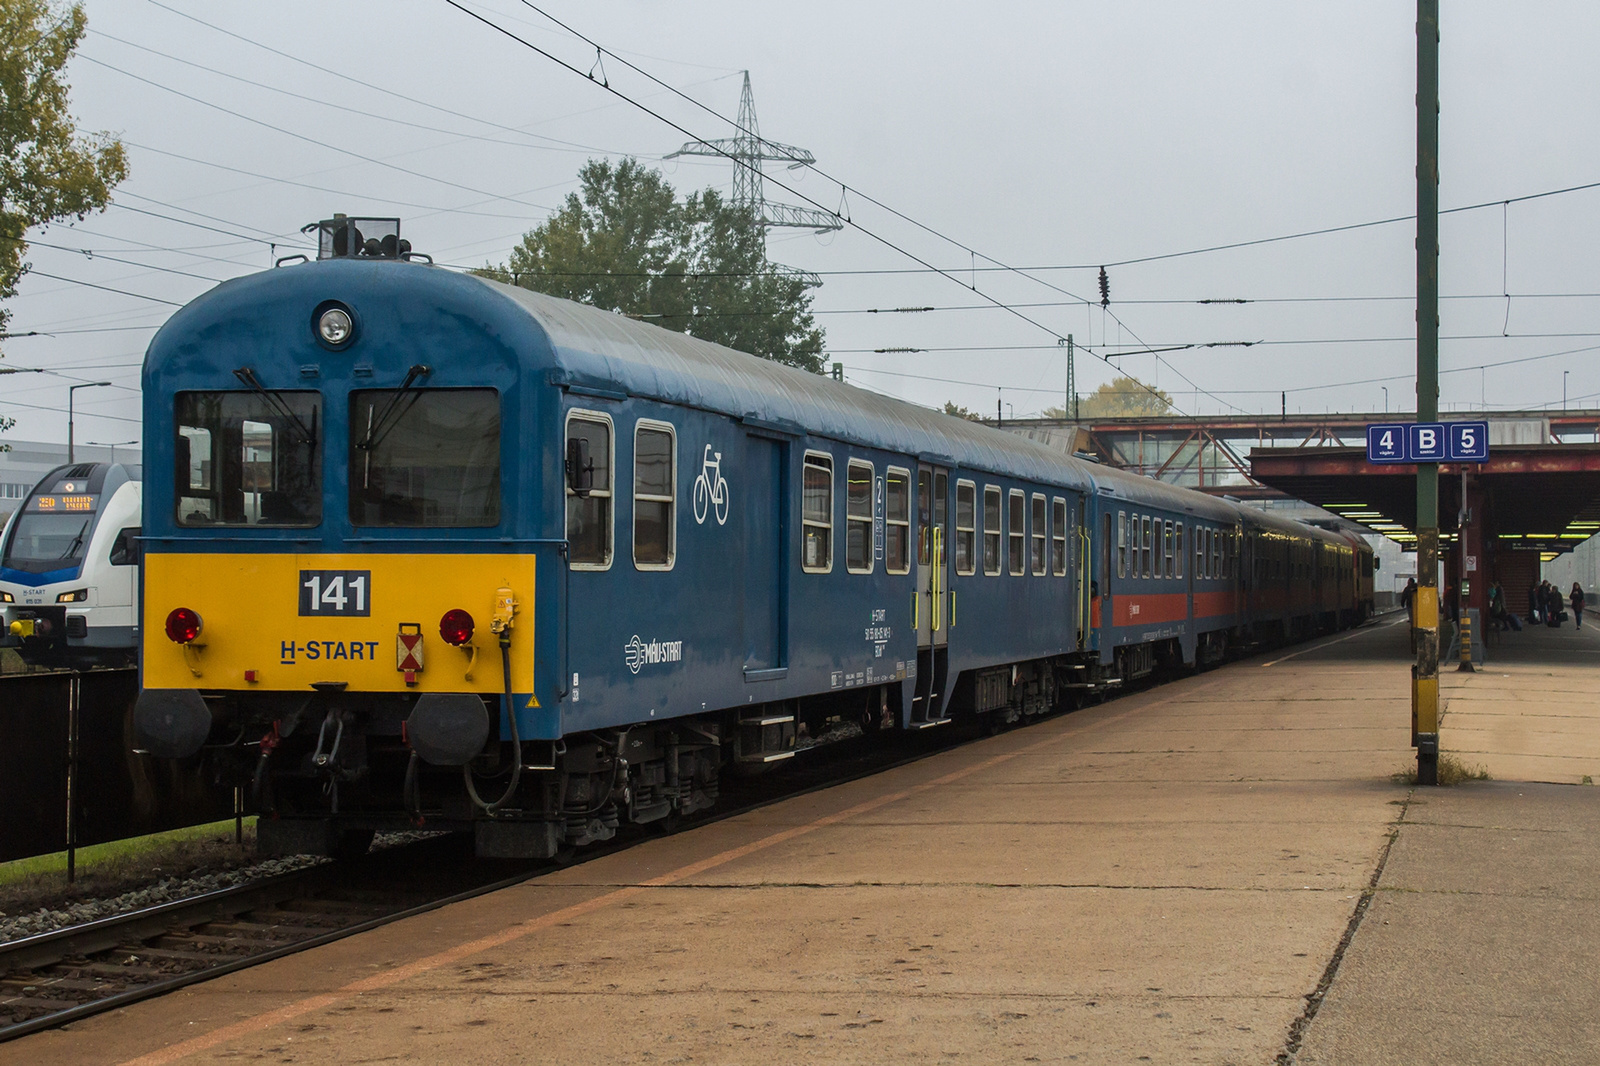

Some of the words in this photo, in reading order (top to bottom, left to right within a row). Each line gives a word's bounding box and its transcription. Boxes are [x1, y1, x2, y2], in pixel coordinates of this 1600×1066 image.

[1379, 430, 1394, 450] 4
[1419, 429, 1437, 449] B
[1460, 428, 1475, 449] 5
[877, 480, 882, 504] 2
[304, 576, 365, 611] 141
[280, 640, 379, 664] H-START
[645, 637, 683, 664] MÁV-START
